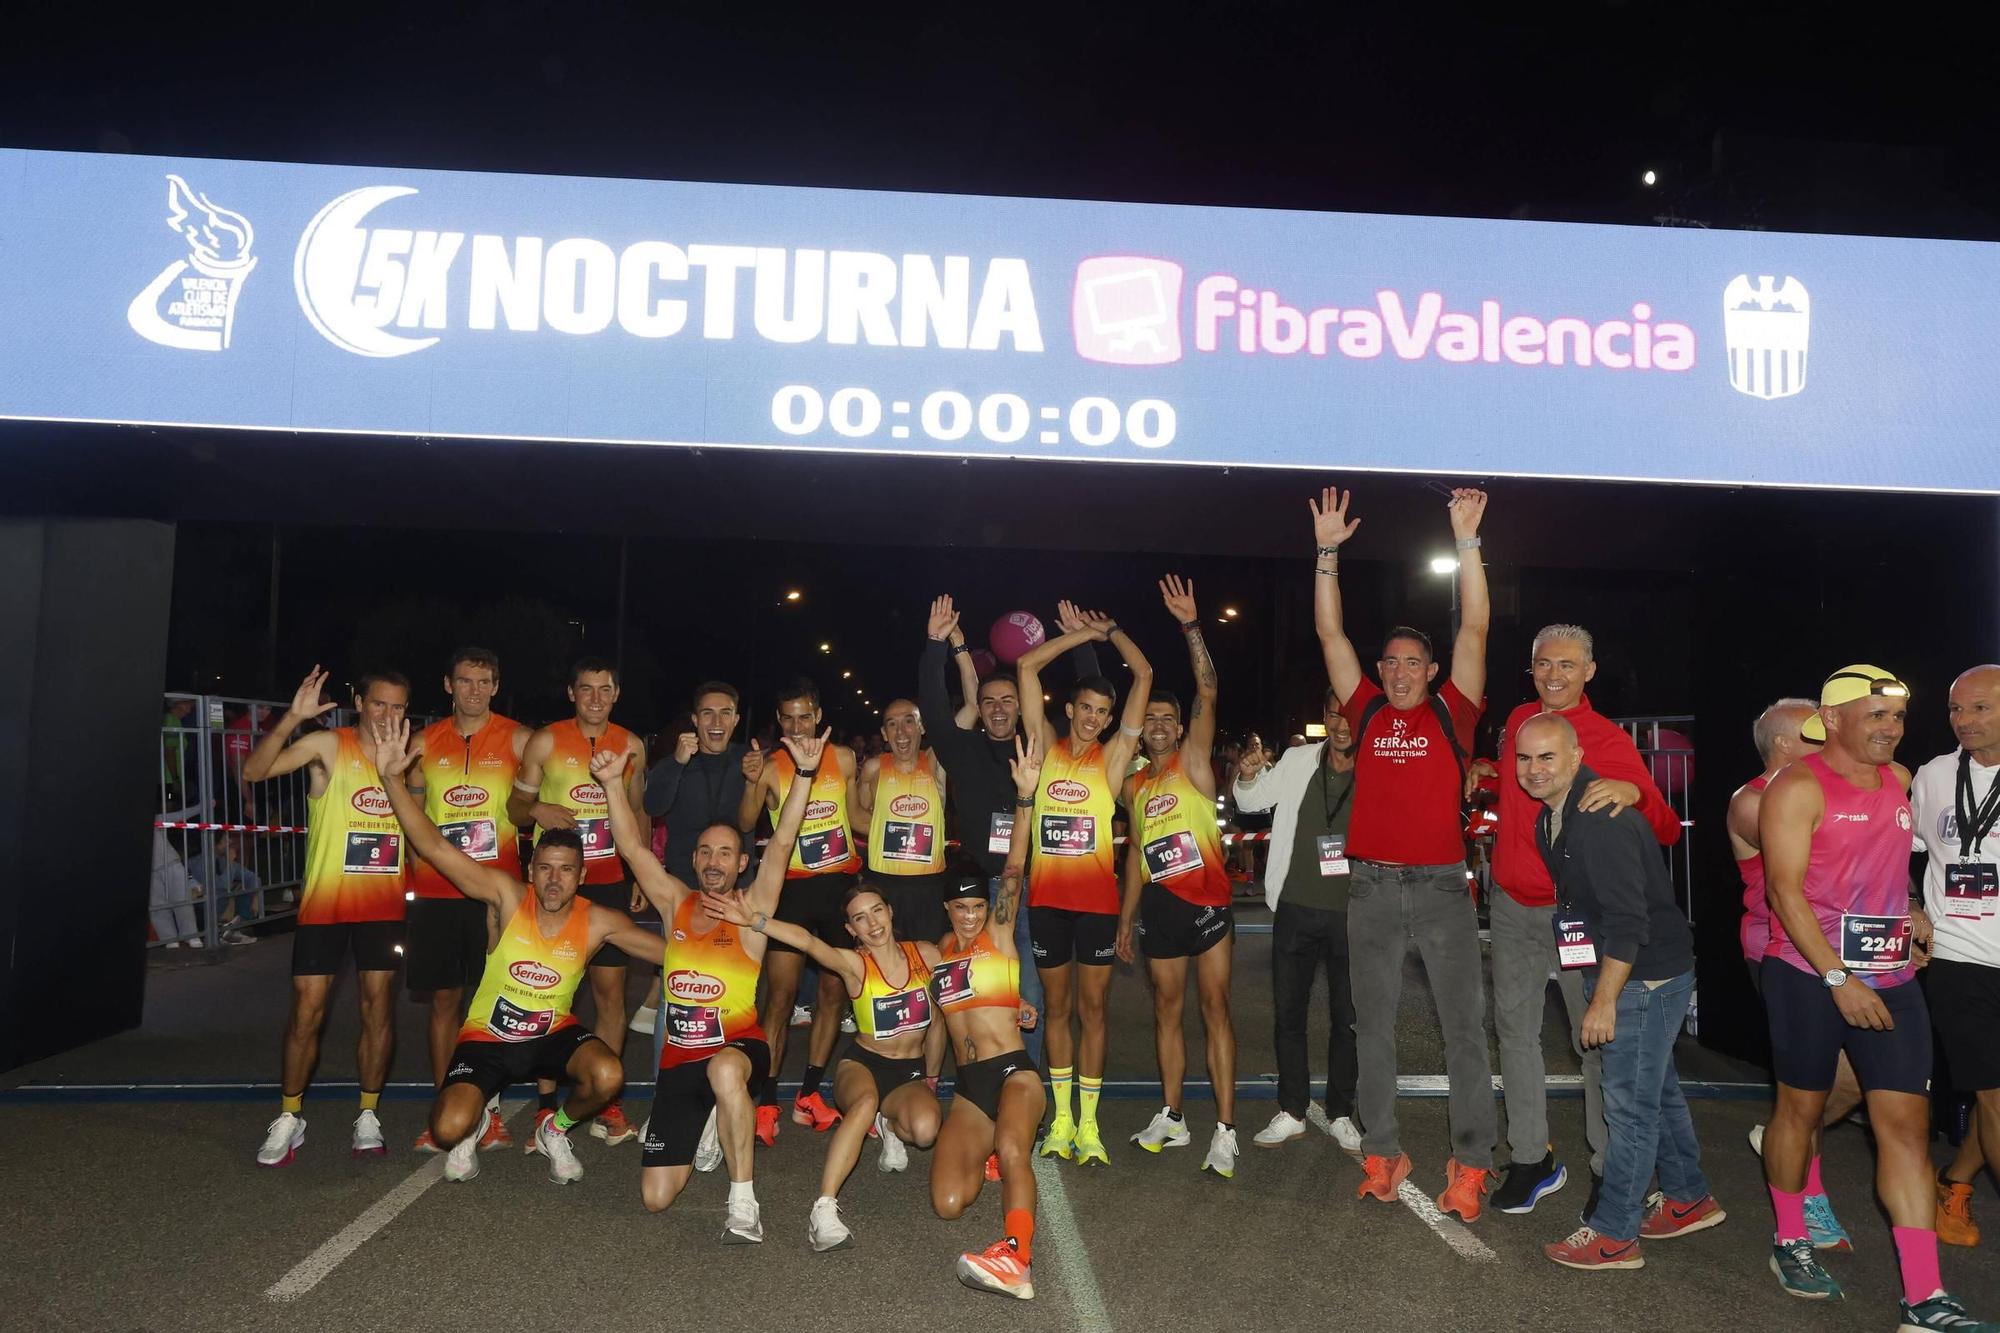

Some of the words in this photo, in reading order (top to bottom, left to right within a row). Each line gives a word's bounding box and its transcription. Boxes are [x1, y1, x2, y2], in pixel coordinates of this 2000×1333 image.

[467, 234, 1045, 352] NOCTURNA
[1194, 273, 1695, 372] FibraValencia
[771, 384, 1177, 448] 00:00:00
[1373, 736, 1429, 749] SERRANO
[449, 791, 485, 802] Serrano
[1050, 784, 1087, 798] Serrano
[357, 793, 392, 809] Serran
[893, 800, 927, 812] Serrano
[996, 827, 1012, 837] VIP
[1046, 829, 1089, 842] 10543
[461, 835, 471, 846] 9
[580, 833, 597, 845] 10
[900, 835, 916, 847] 14
[370, 847, 380, 859] 8
[821, 843, 830, 855] 2
[1158, 847, 1183, 863] 103
[1324, 850, 1342, 859] VIP
[1958, 884, 1966, 895] 1
[1563, 932, 1585, 943] VIP
[1860, 936, 1904, 952] 2241
[514, 965, 557, 984] Serrano
[670, 976, 720, 995] Serrano
[938, 975, 953, 990] 12
[896, 1007, 910, 1021] 11
[502, 1015, 538, 1032] 1260
[674, 1019, 707, 1032] 1255
